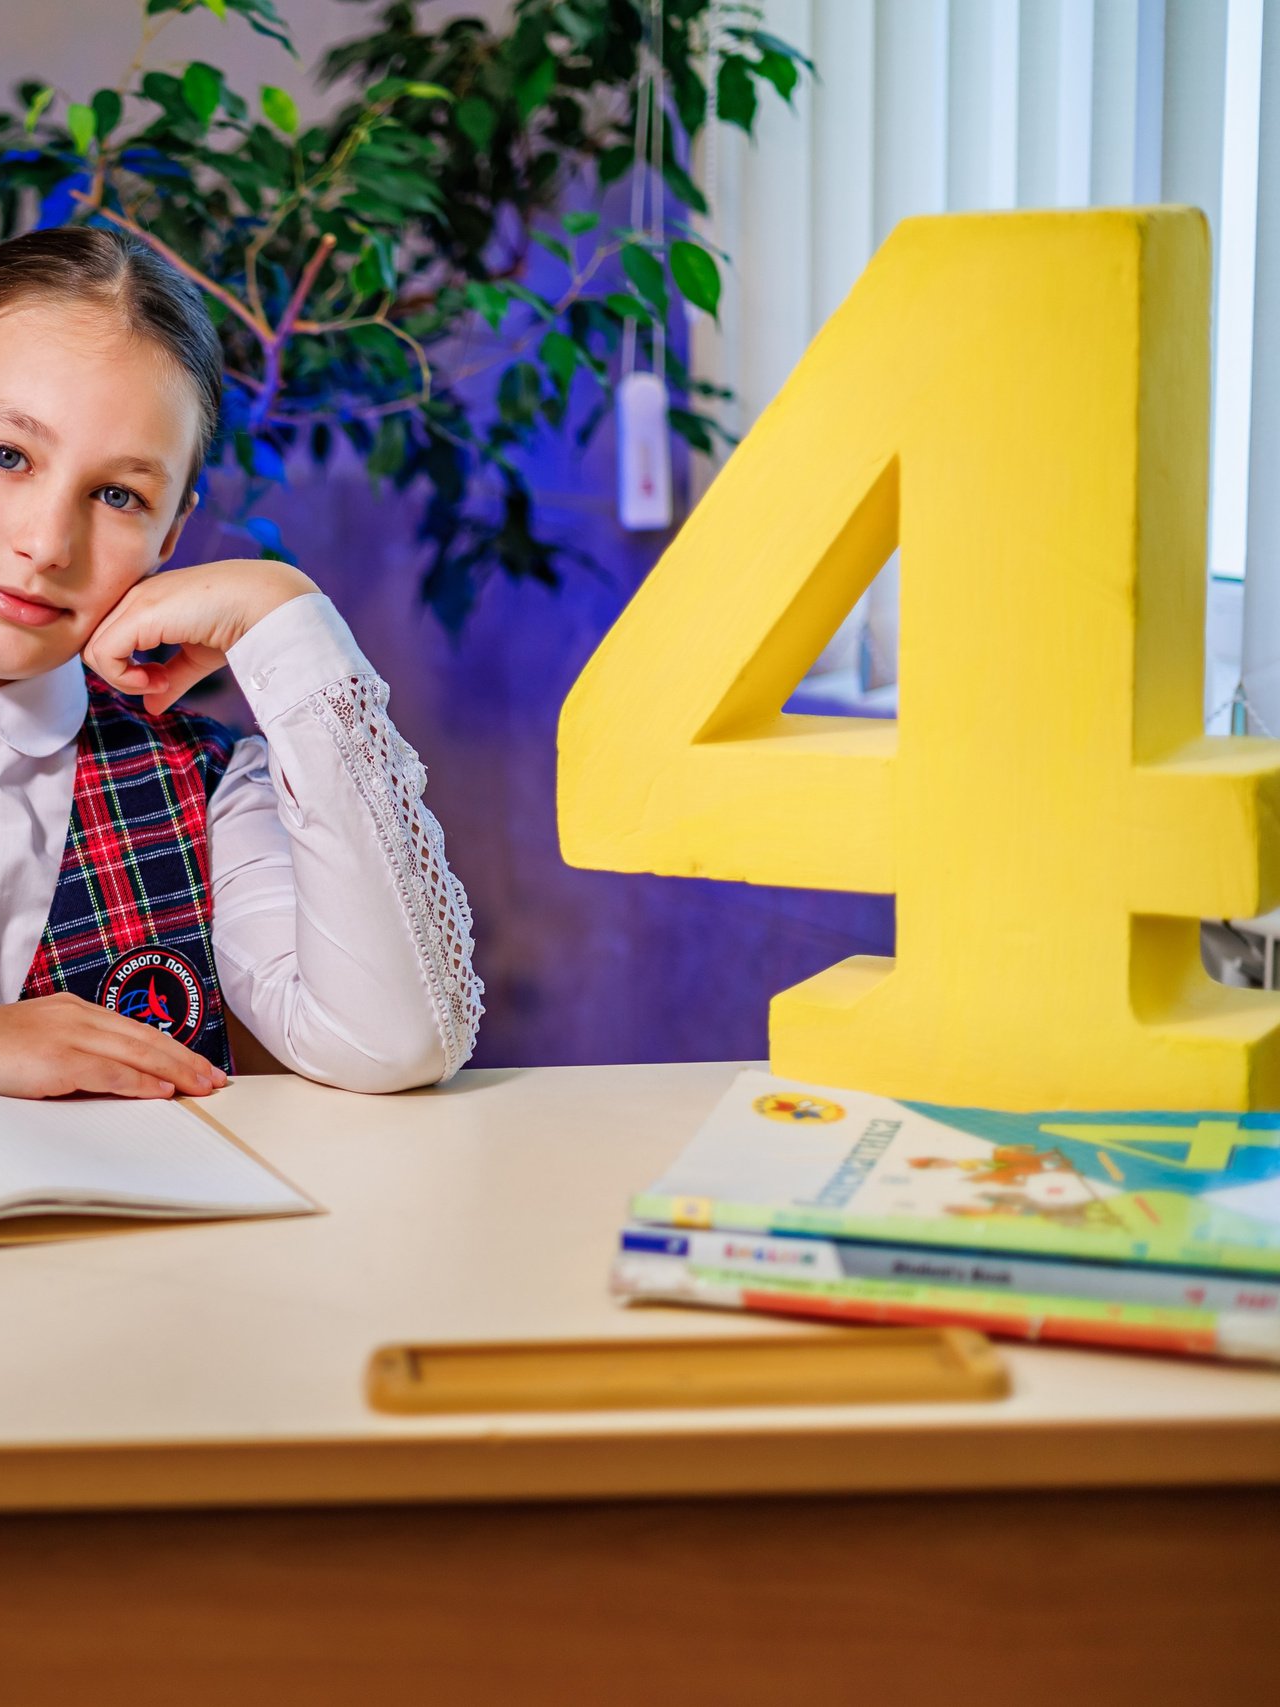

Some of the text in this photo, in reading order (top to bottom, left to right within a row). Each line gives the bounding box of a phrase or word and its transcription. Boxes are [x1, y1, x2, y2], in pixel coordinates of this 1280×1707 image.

[558, 203, 1280, 1112] 4
[105, 954, 200, 1028] ОЛА НОВОГО ПОКОЛЕНИЯ
